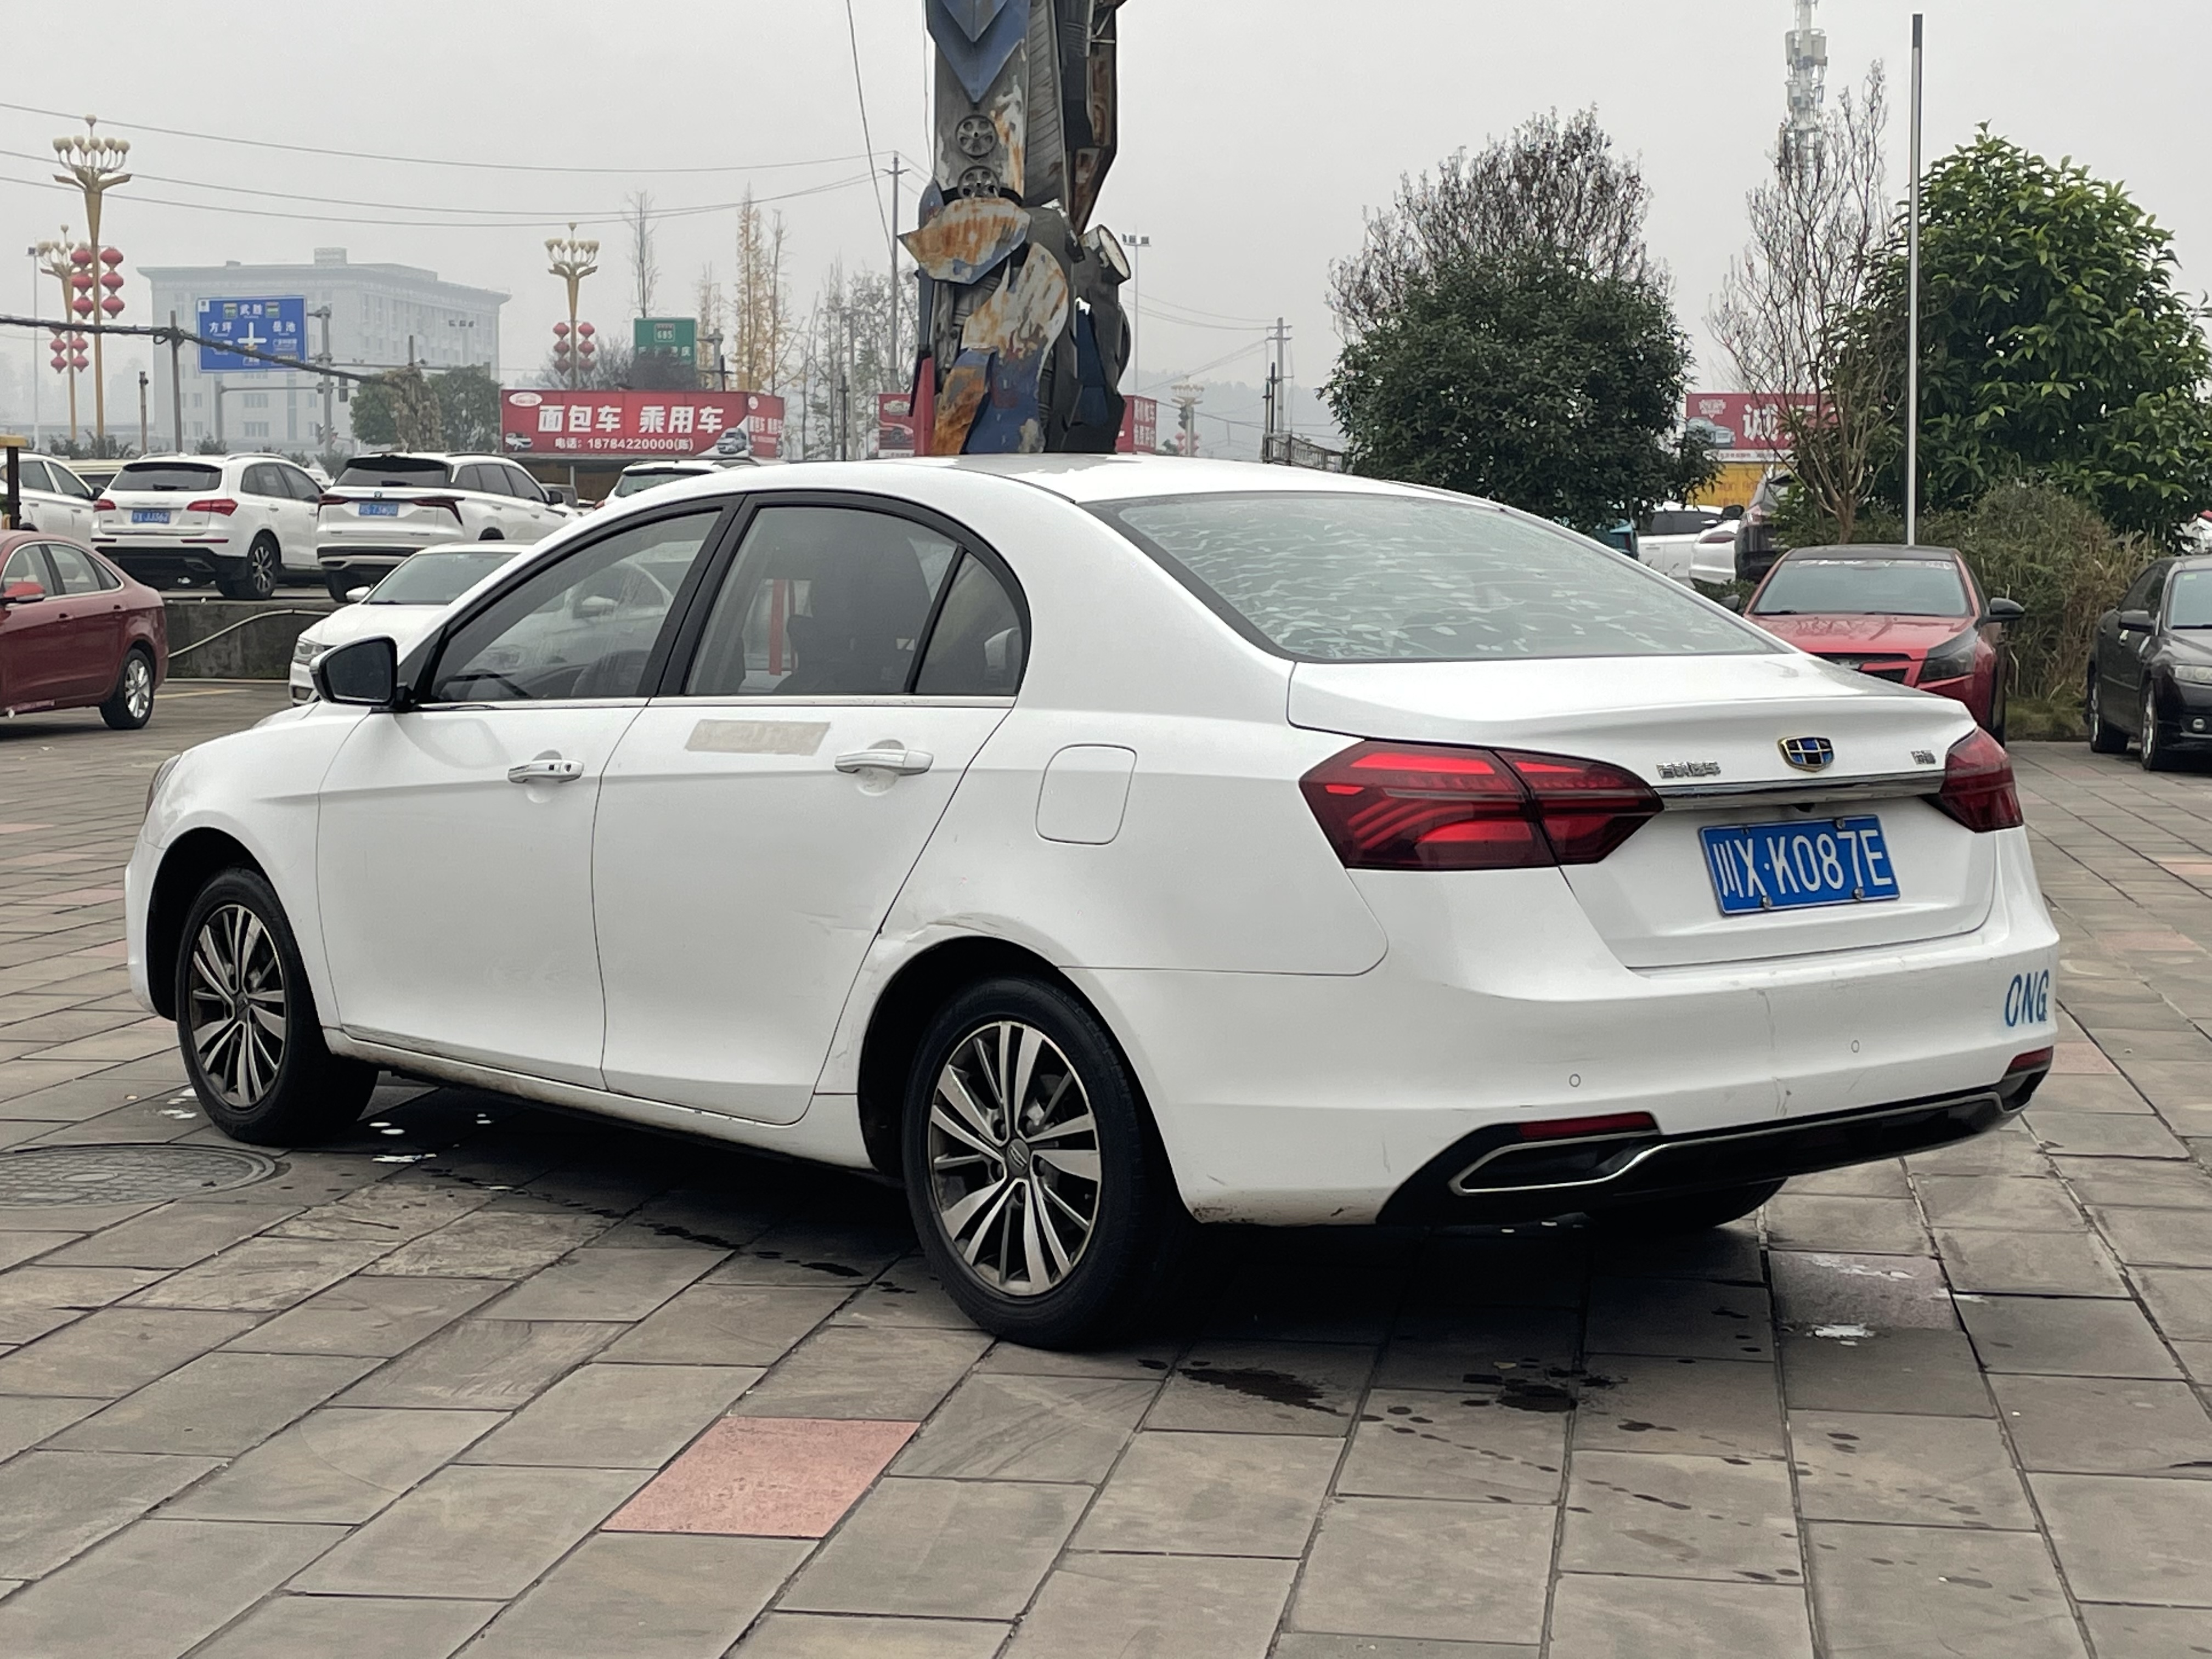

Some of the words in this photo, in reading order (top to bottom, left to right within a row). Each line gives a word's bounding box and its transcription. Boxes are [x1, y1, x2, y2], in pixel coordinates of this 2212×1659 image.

[538, 405, 623, 432] 面包车
[639, 405, 724, 433] 乘用车
